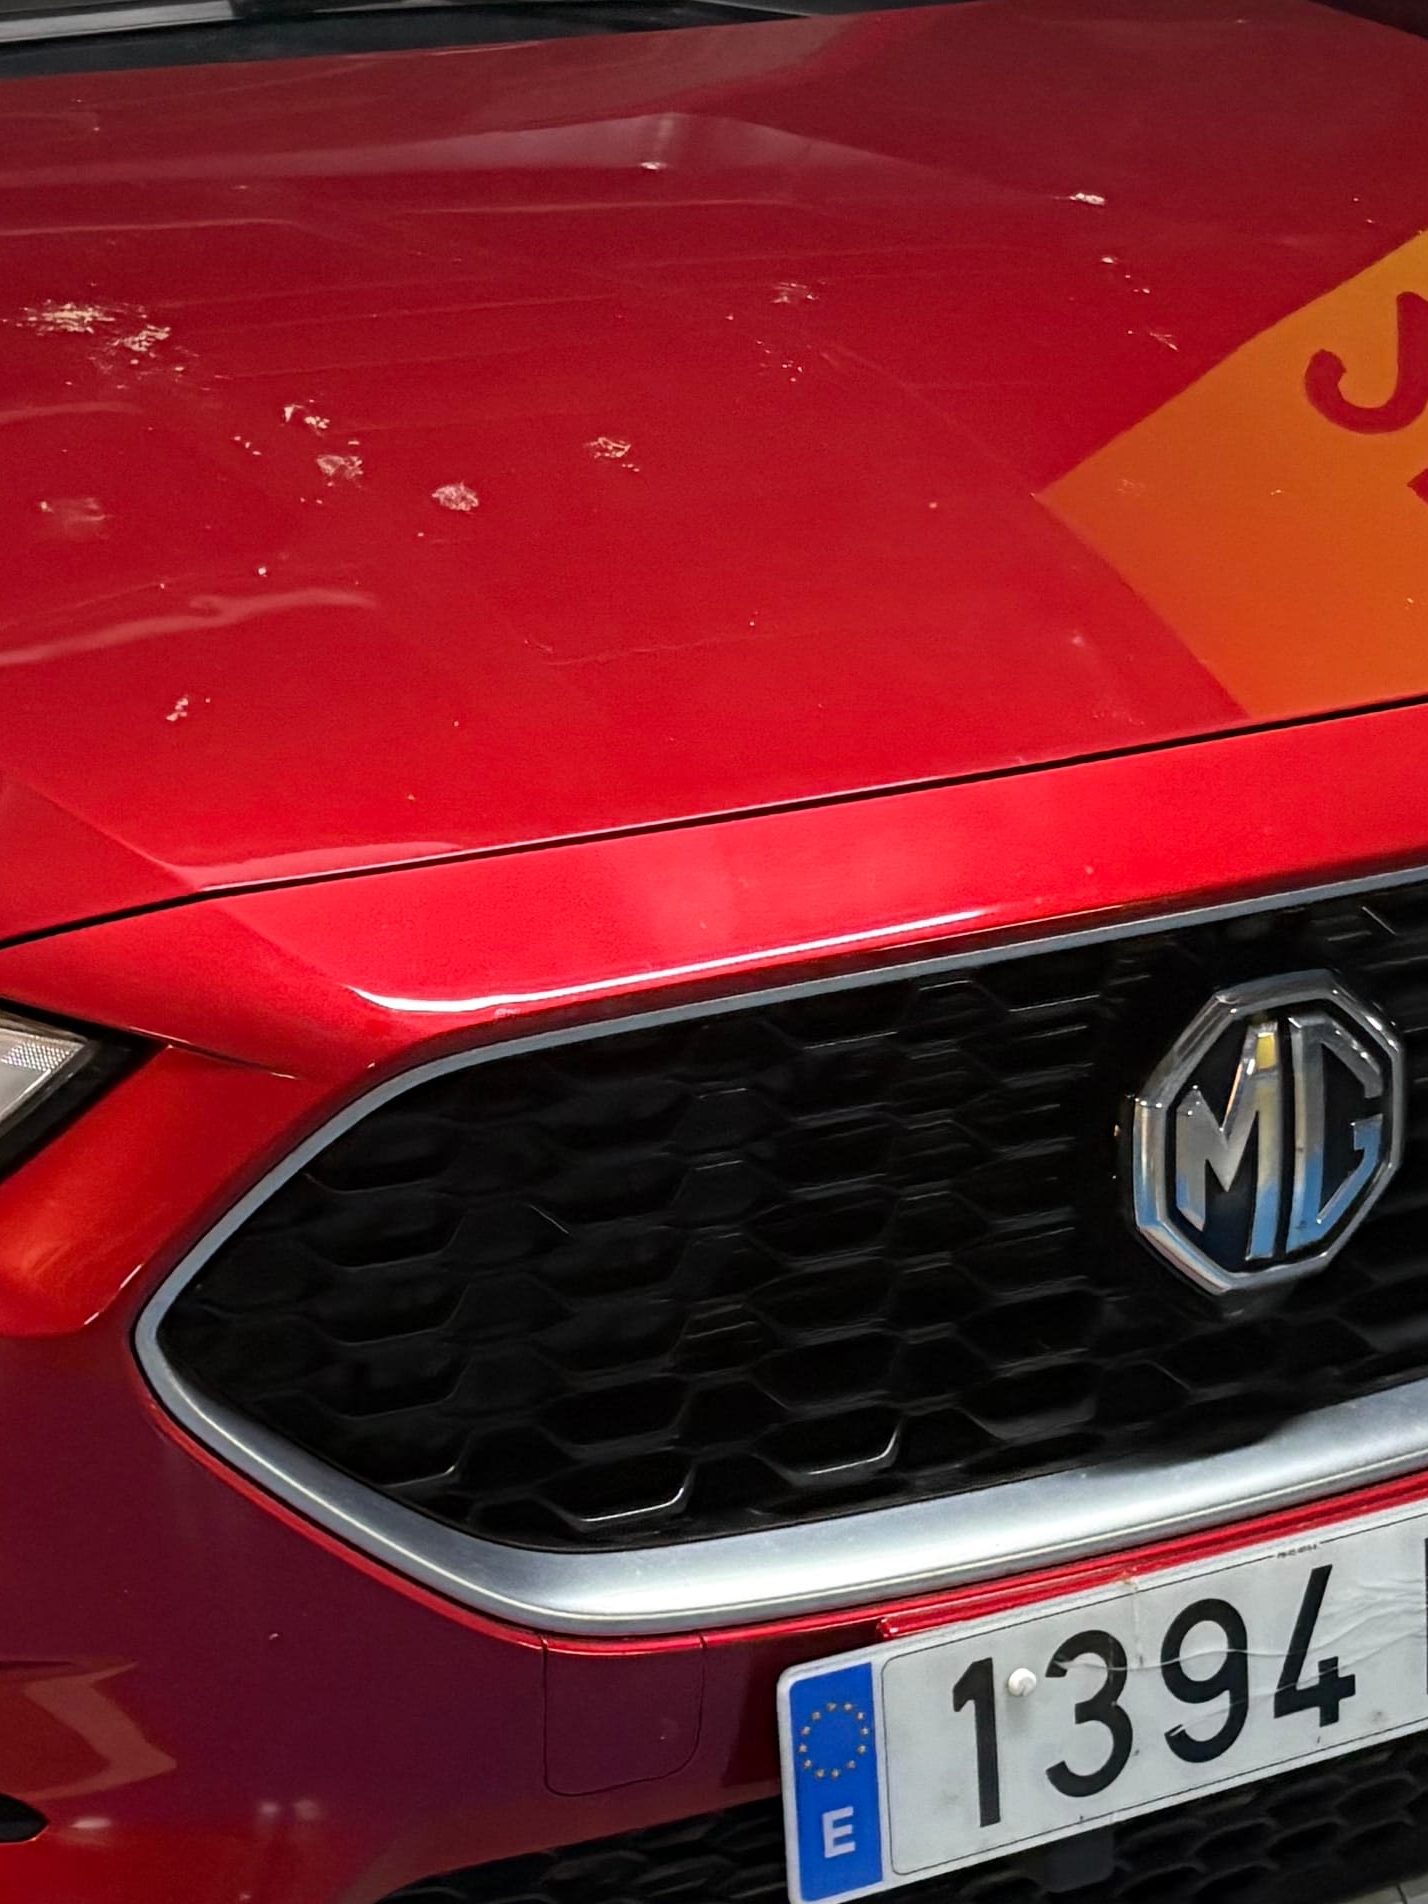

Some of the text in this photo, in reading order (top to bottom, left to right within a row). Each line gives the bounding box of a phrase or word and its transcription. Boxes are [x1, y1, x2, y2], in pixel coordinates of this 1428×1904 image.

[1175, 1014, 1384, 1261] MG
[951, 1564, 1357, 1827] 1394
[822, 1806, 857, 1858] E
